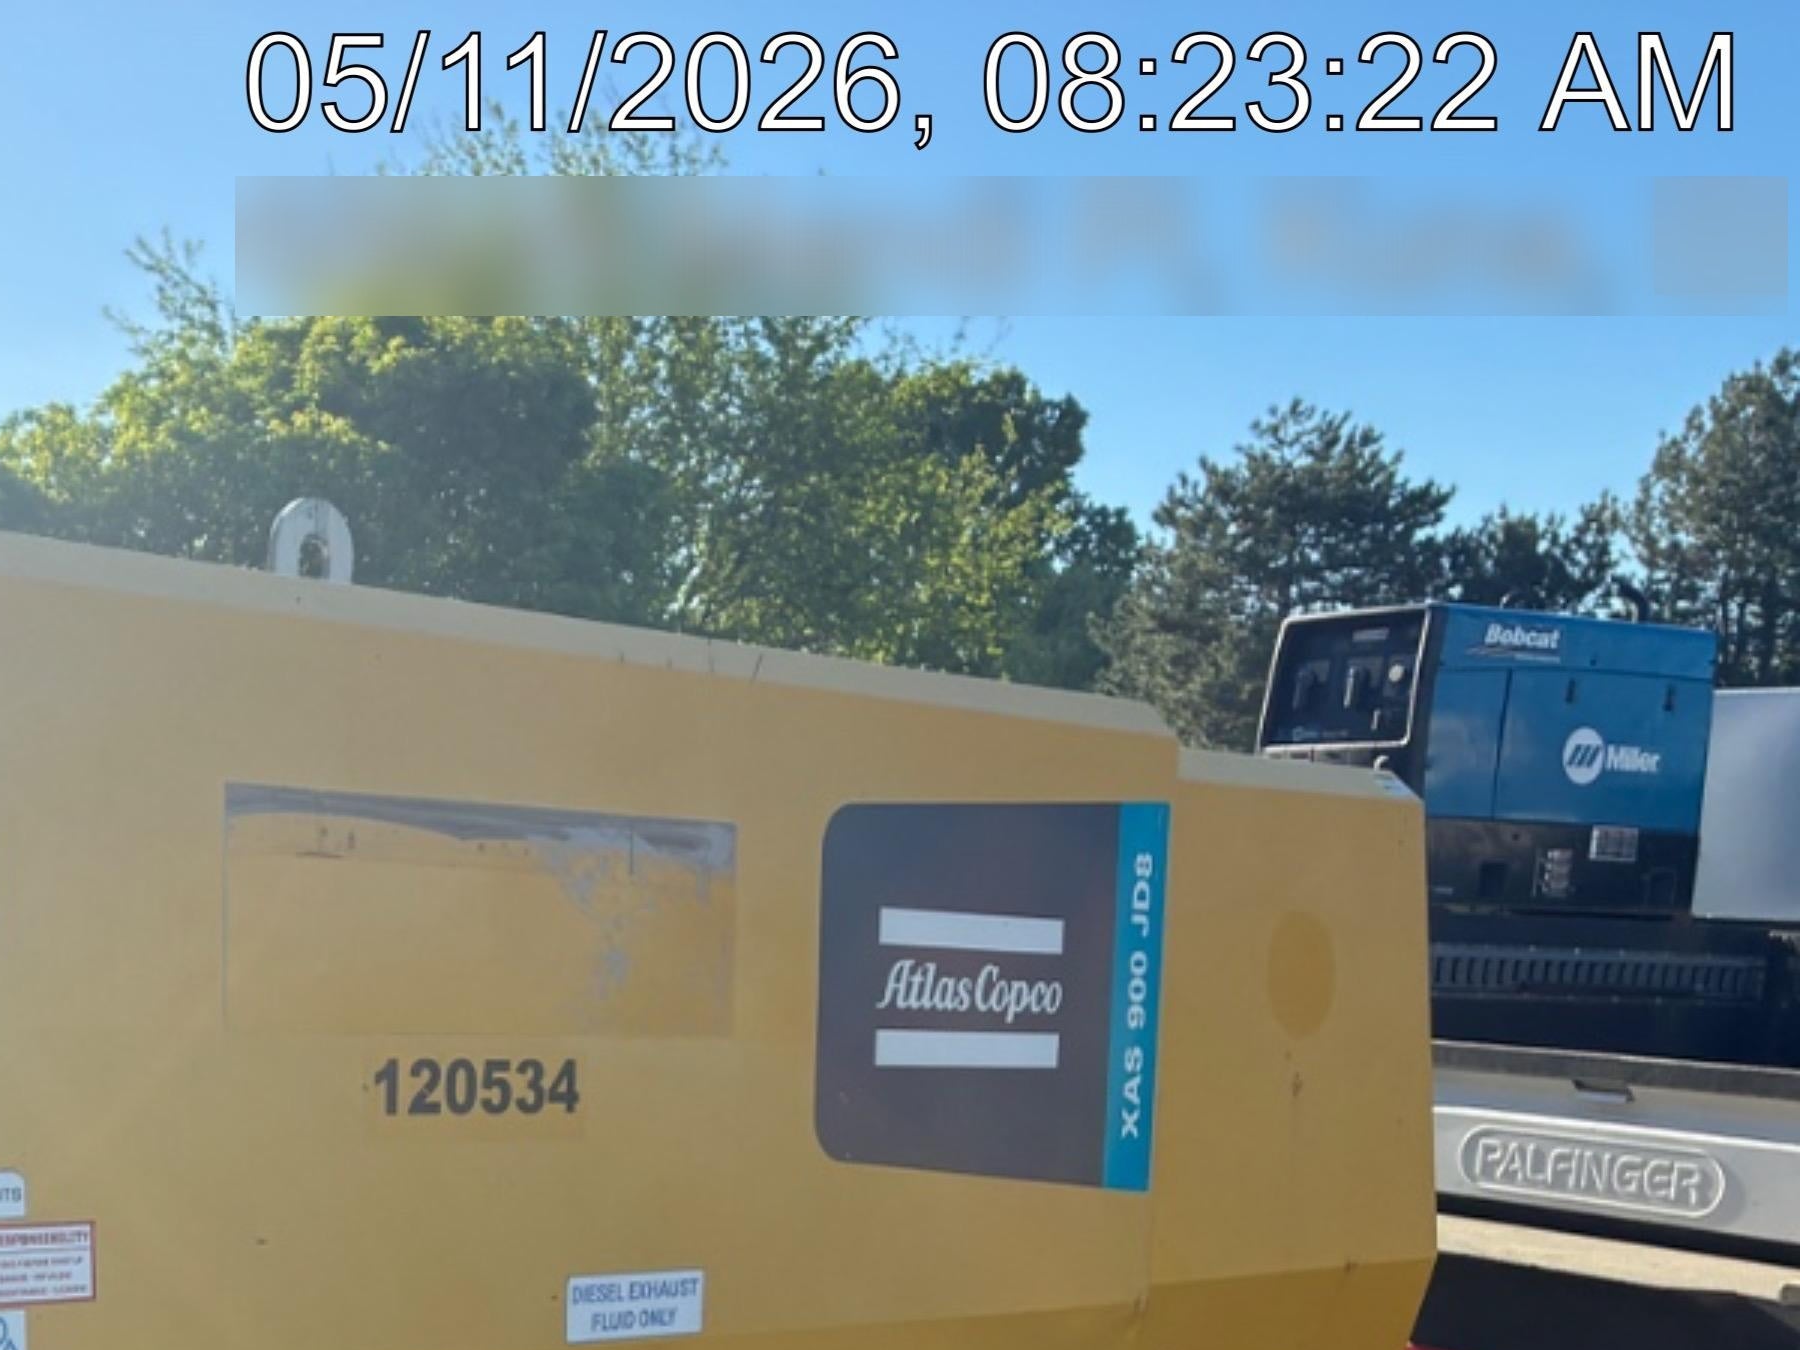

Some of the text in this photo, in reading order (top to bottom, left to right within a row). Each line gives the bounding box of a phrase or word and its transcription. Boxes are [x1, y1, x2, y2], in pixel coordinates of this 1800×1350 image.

[1485, 623, 1561, 650] Bobcat
[1605, 743, 1661, 773] Miller
[876, 958, 1063, 1024] Atlas Copco
[1121, 852, 1154, 1138] XAS 900 JD8
[372, 1058, 580, 1116] 120534
[1475, 1139, 1704, 1206] PALFINGER
[572, 1278, 699, 1304] DIESEL EXHAUST
[590, 1307, 678, 1332] FLUID ONLY
